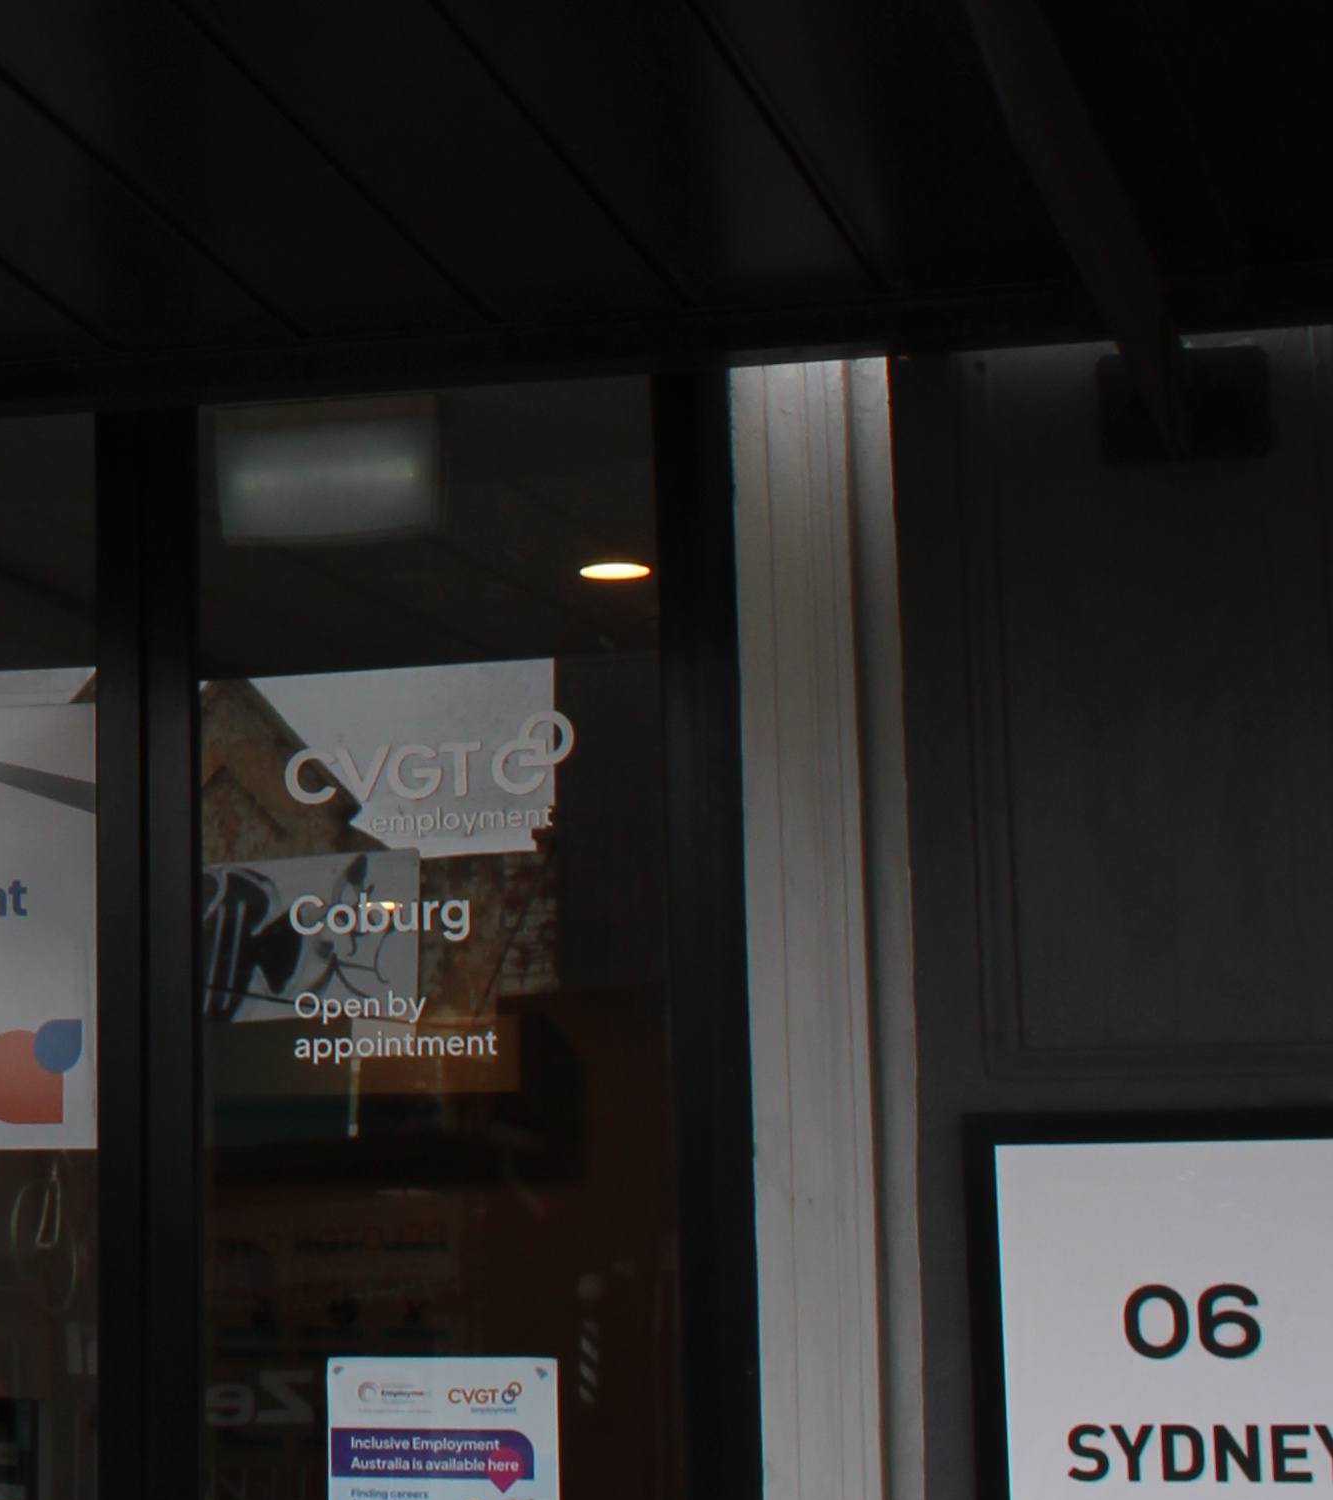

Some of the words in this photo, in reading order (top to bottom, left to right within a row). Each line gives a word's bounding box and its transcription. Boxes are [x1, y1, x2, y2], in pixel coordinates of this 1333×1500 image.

[283, 740, 482, 805] CVGT
[370, 804, 554, 838] employment
[288, 894, 471, 942] Coburg
[294, 991, 381, 1024] Open
[387, 989, 427, 1024] by
[293, 1029, 498, 1065] appointment
[447, 1387, 499, 1405] CVGT
[350, 1436, 409, 1450] Inclusive
[412, 1436, 500, 1453] Employment
[350, 1456, 410, 1471] Australia
[412, 1457, 423, 1471] is
[425, 1457, 485, 1471] available
[488, 1458, 520, 1472] here
